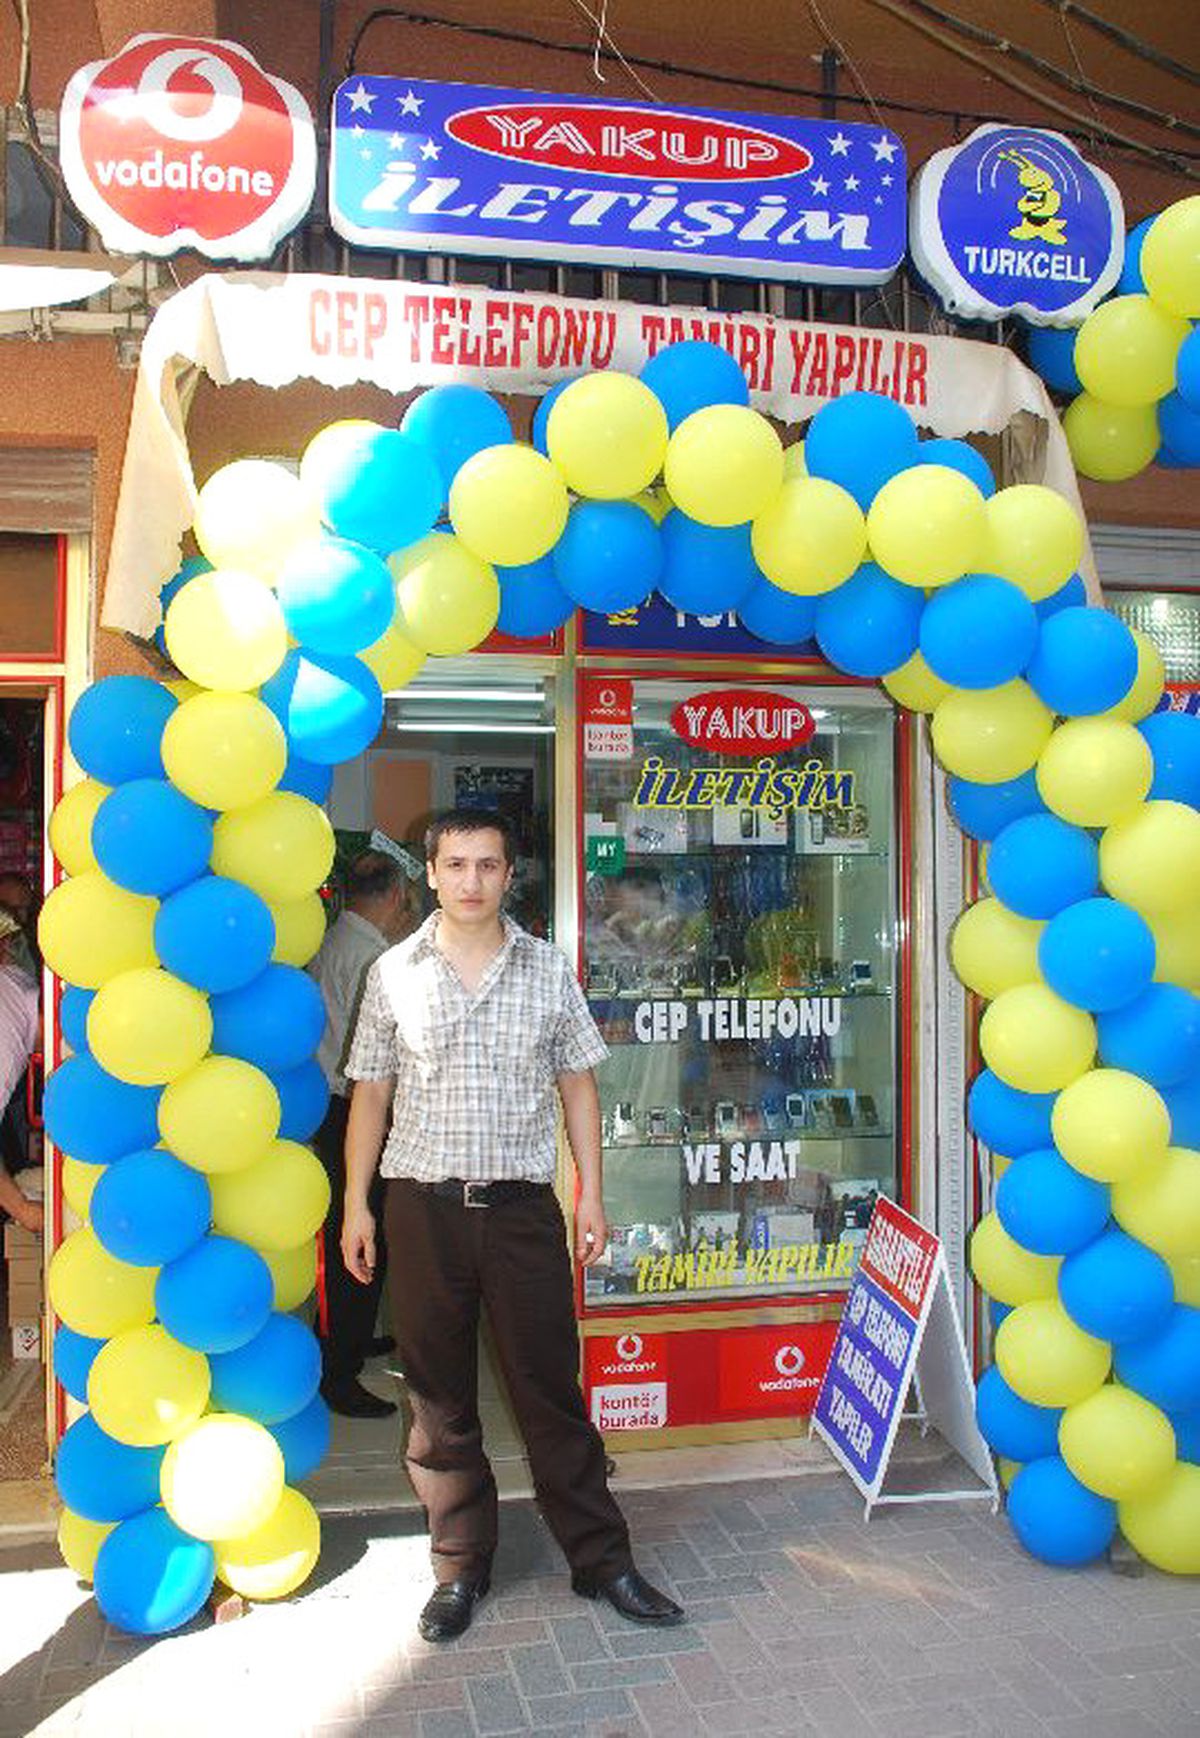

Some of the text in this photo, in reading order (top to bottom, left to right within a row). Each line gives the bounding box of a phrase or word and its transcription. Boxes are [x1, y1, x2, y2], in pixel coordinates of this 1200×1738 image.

[486, 117, 780, 169] YAKUP
[94, 152, 275, 197] vodafone
[362, 161, 872, 251] İLETİŞİM
[964, 246, 1091, 284] TURKCELL
[308, 289, 387, 361] CEP
[404, 296, 616, 370] TELEFONU
[789, 330, 928, 406] YAPILIR
[682, 705, 807, 740] YAKUP
[636, 760, 851, 820] İLETİŞİM
[634, 997, 842, 1043] CEP TELEFONU
[682, 1141, 801, 1186] VE SAAT
[601, 1360, 657, 1374] vodafone
[759, 1376, 820, 1391] vodafone
[599, 1413, 660, 1432] burada
